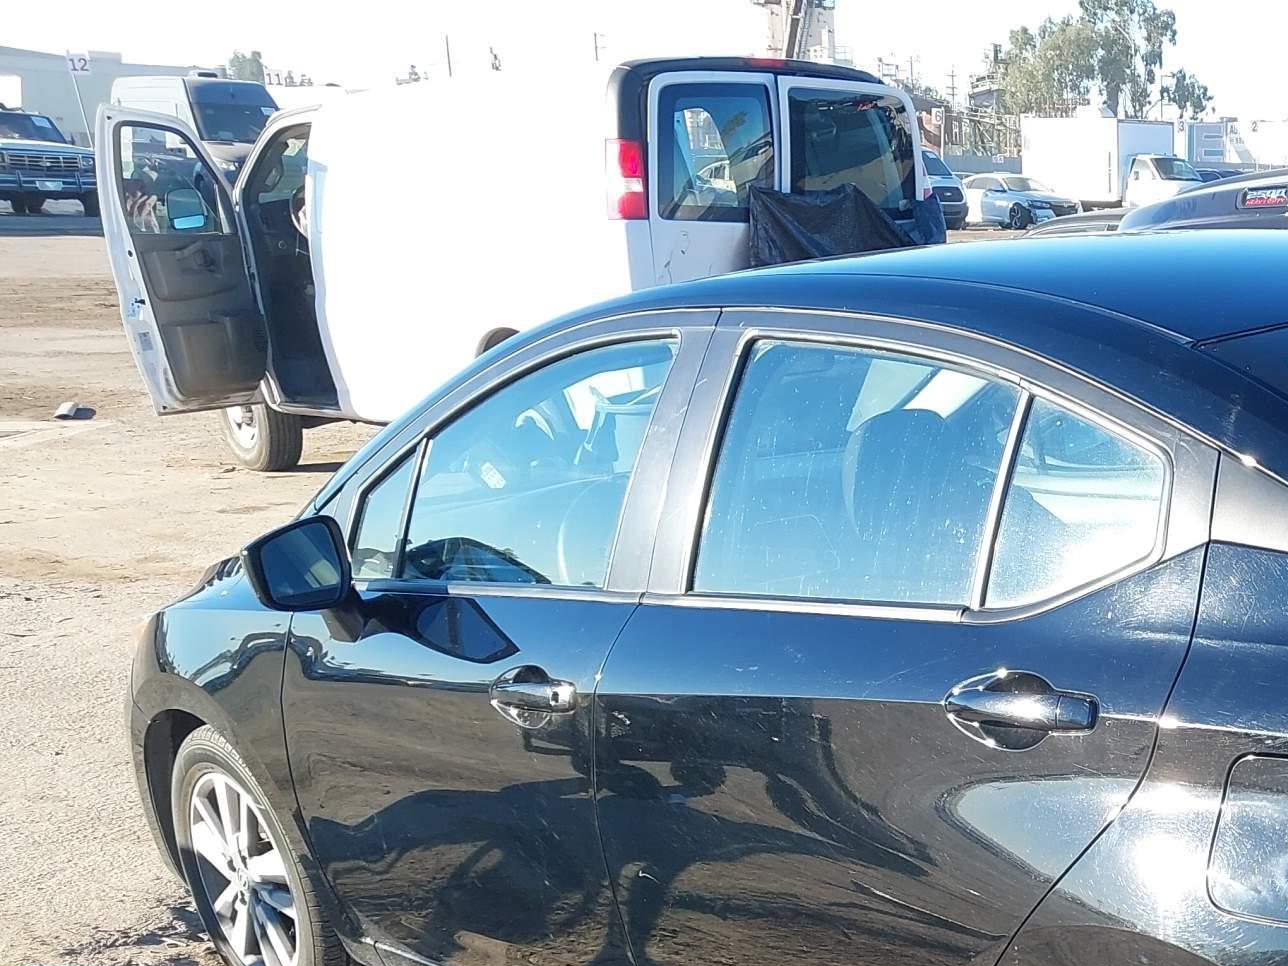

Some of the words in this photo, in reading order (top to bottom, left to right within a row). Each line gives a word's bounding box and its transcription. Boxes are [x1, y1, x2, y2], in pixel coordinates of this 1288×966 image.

[68, 58, 89, 71] 12
[266, 73, 283, 85] 11
[935, 110, 942, 122] 6
[1178, 121, 1185, 132] 3
[1251, 121, 1258, 132] 2
